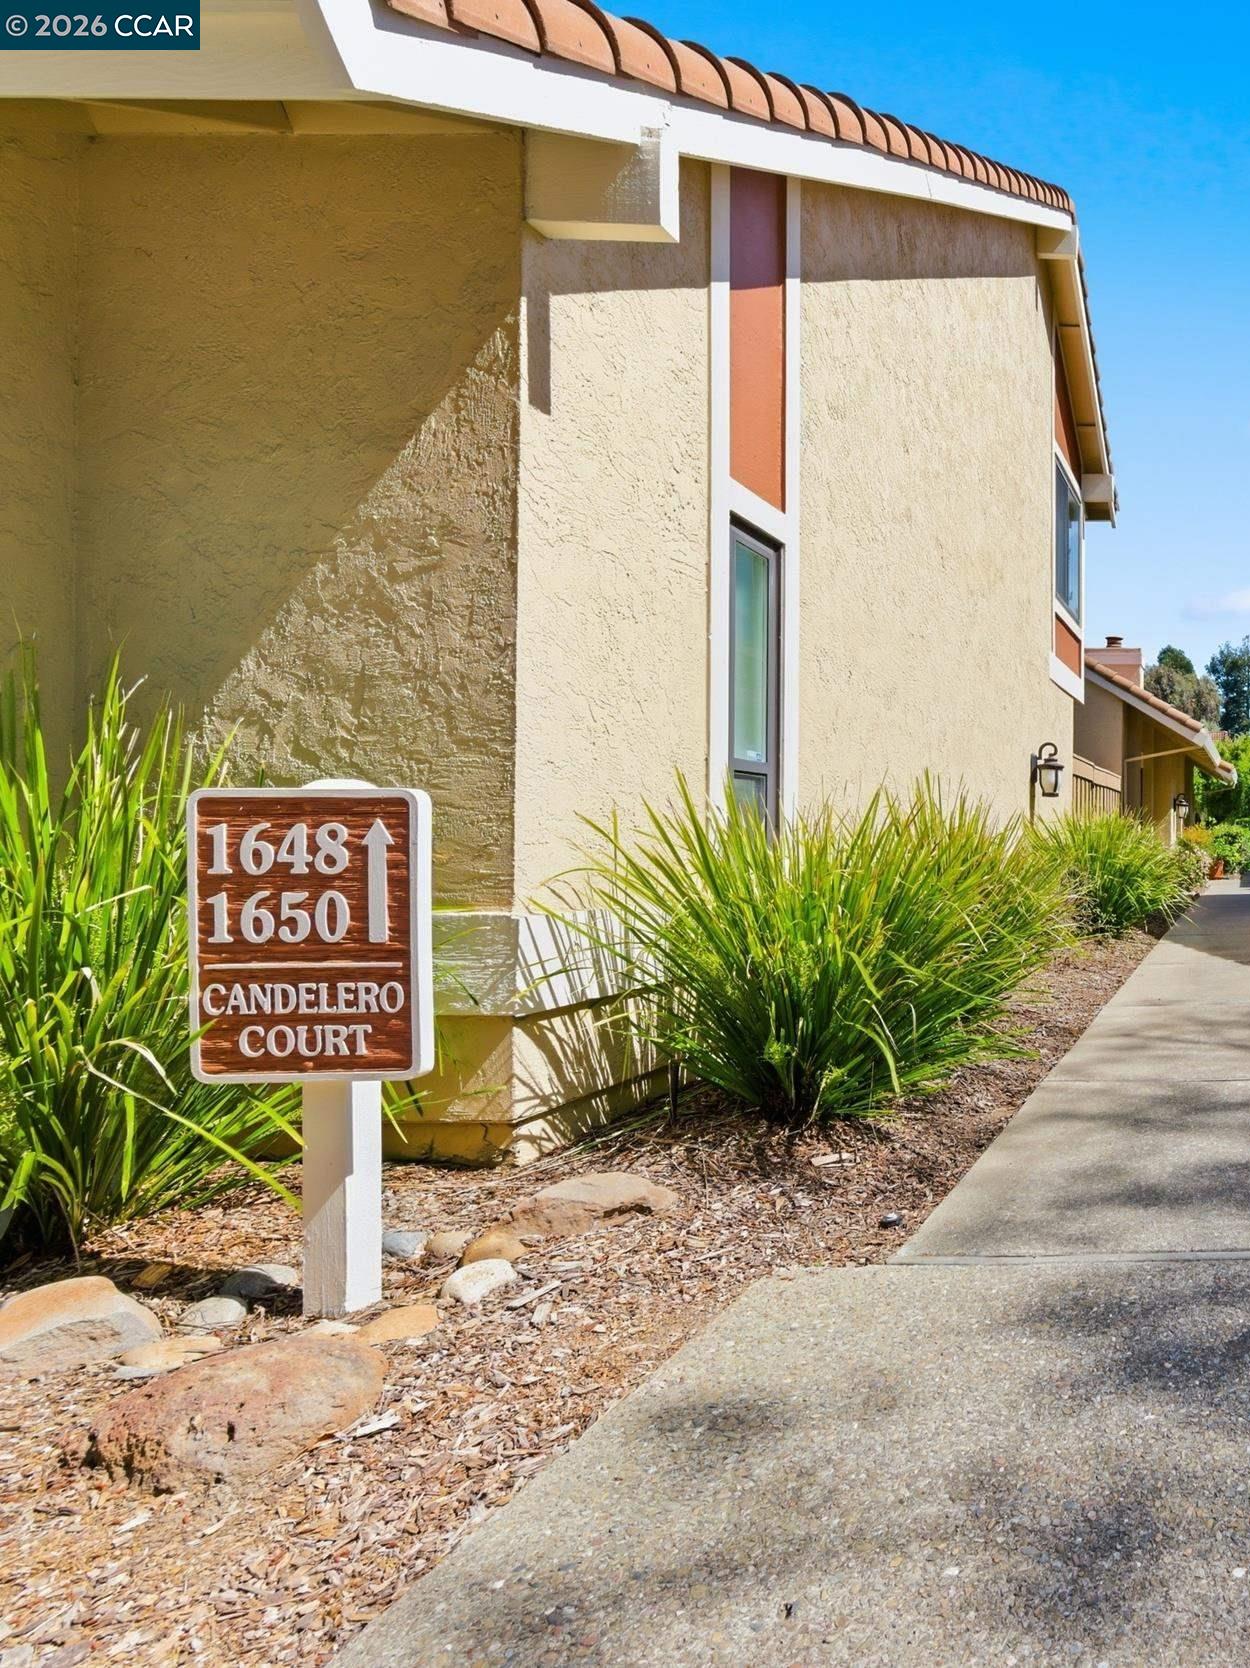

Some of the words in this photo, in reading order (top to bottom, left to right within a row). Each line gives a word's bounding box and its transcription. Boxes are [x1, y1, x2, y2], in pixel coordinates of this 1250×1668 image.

[206, 822, 349, 876] 1648
[206, 890, 350, 944] 1650
[202, 981, 405, 1016] CANDELERO
[238, 1024, 372, 1057] COURT
